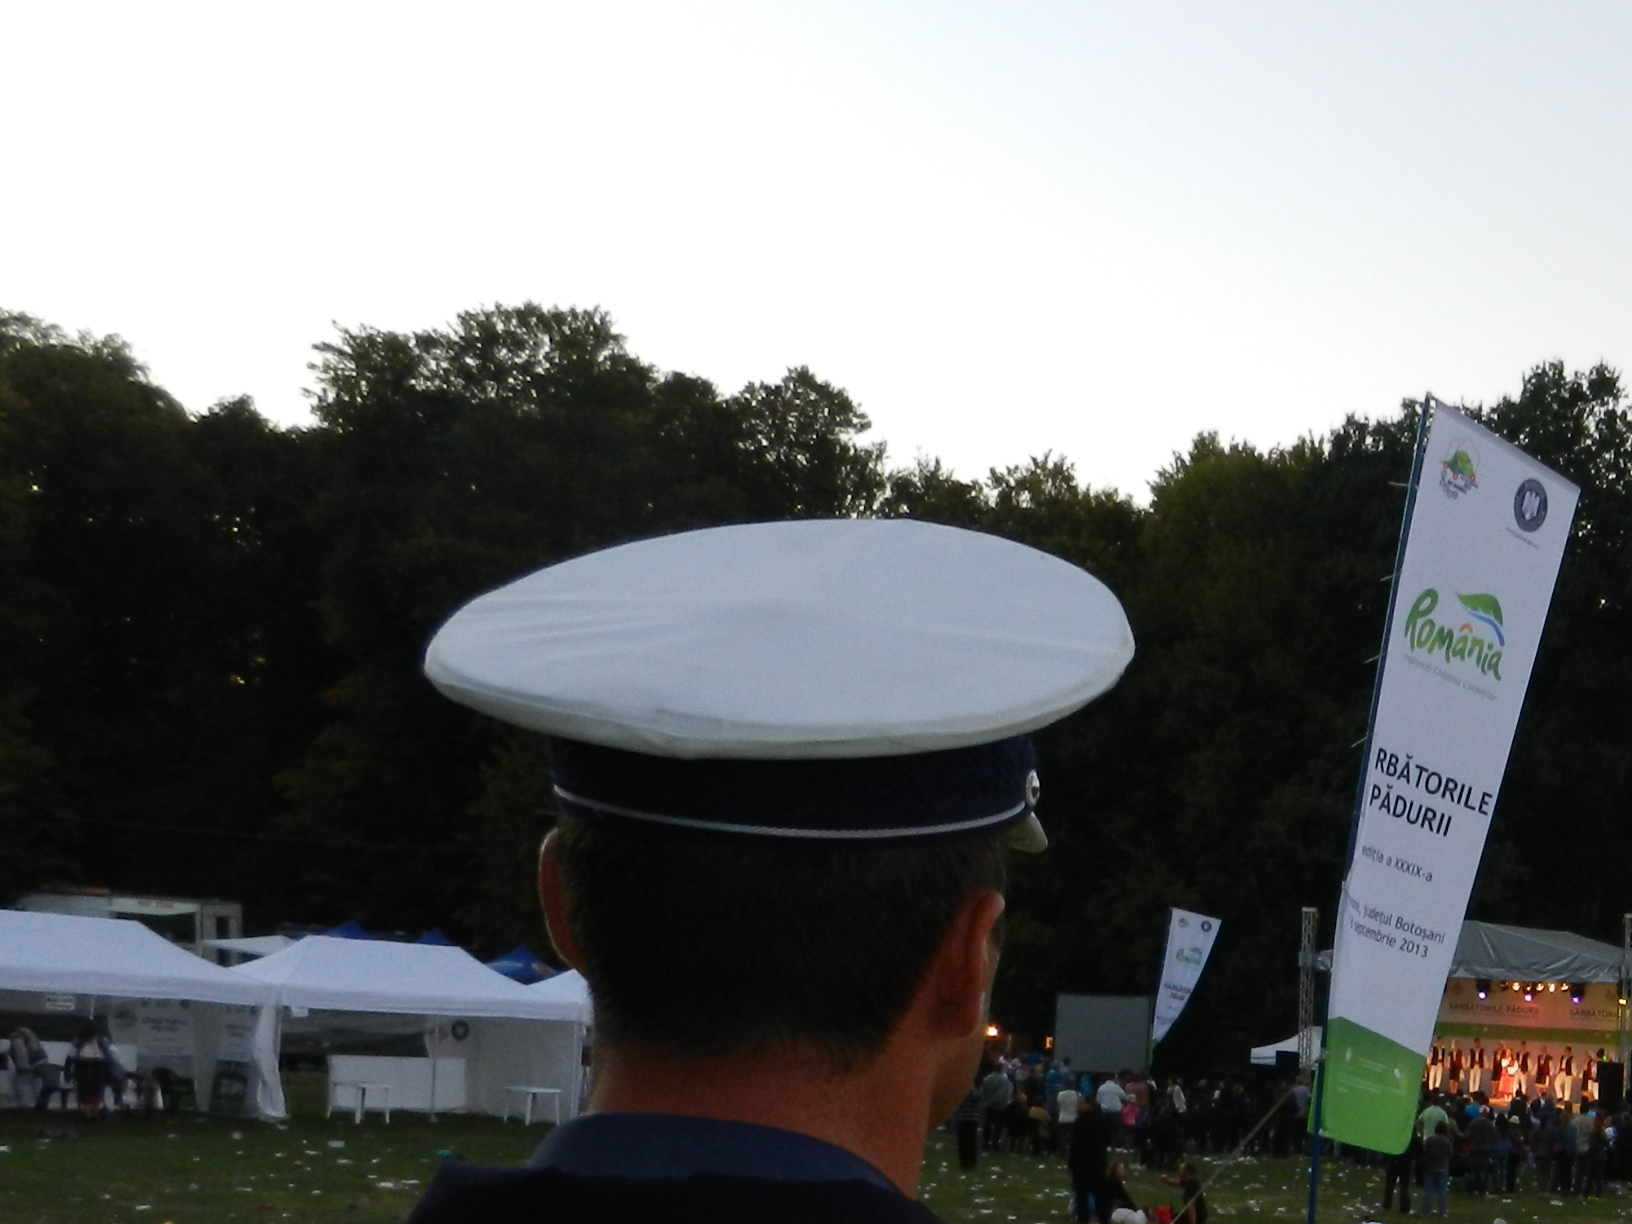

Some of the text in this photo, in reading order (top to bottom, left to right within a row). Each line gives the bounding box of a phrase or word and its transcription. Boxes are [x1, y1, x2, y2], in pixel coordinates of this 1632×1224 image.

[1404, 588, 1503, 681] România
[1374, 747, 1494, 817] RBĂTORILE
[1369, 783, 1453, 838] PĂDURII
[1395, 916, 1447, 945] Botoșani
[1399, 937, 1430, 959] 2013
